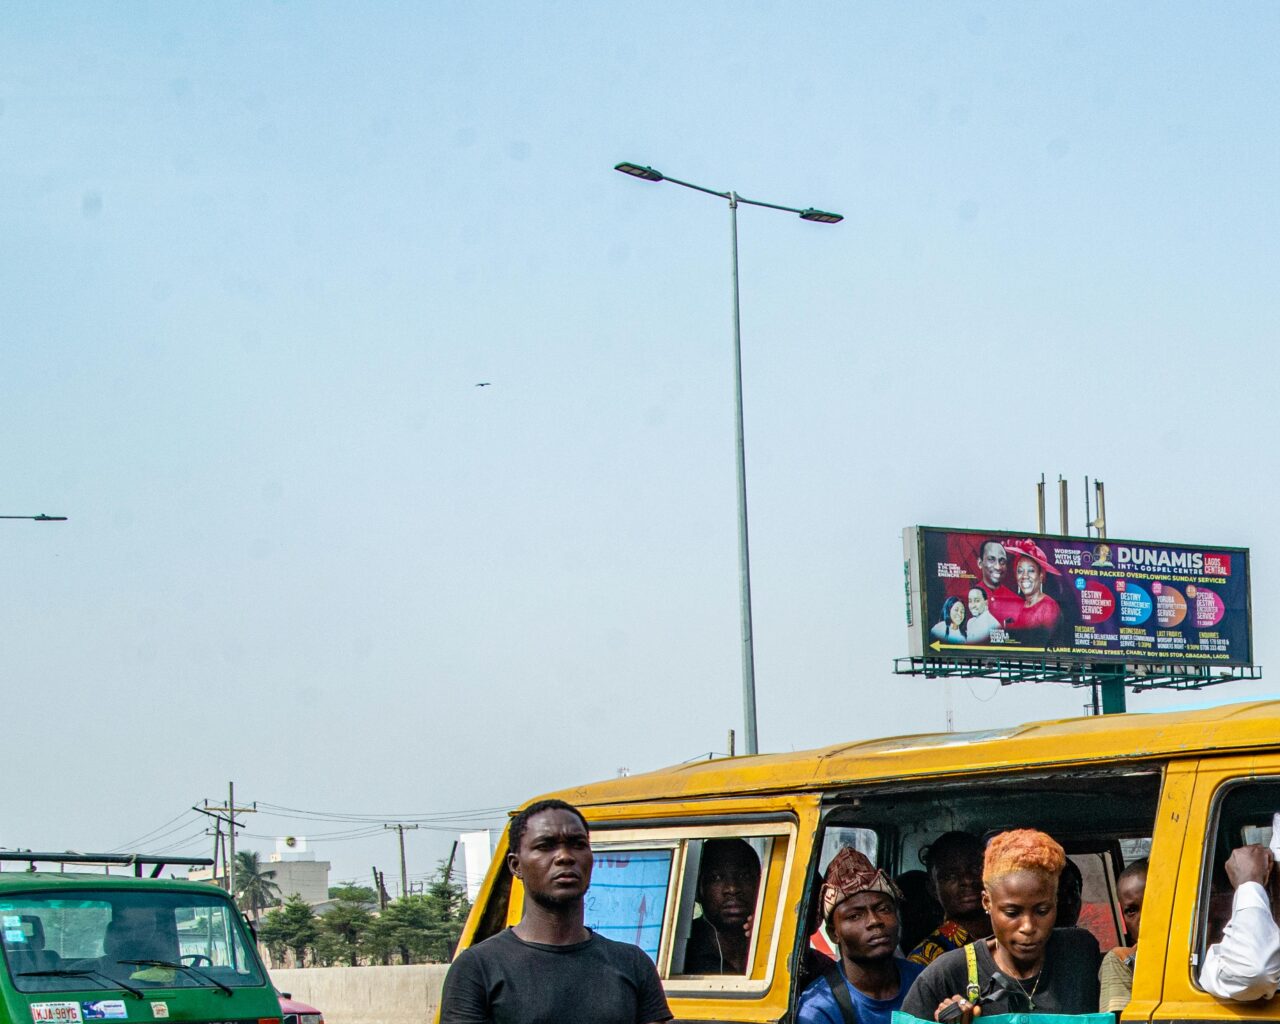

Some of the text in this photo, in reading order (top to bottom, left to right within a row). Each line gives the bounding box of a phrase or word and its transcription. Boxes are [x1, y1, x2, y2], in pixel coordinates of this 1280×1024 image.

[1118, 547, 1203, 568] DUNAMIS
[1204, 558, 1221, 566] LAGOS
[1118, 563, 1203, 575] INT'L GOSPEL CENTRE
[1204, 565, 1227, 575] CENTRAL
[1126, 571, 1171, 580] OVERFLOWING
[1172, 575, 1197, 583] SUNDAY
[1081, 590, 1102, 599] DESTINY
[1120, 593, 1141, 601] DESTINY
[1081, 598, 1112, 606] ENHANCEMENT
[1120, 600, 1150, 608] ENHANCEMENT
[1081, 606, 1103, 614] SERVICE
[1121, 607, 1141, 616] SERVICE
[1157, 609, 1176, 617] SERVICE
[1196, 612, 1215, 620] SERVICE
